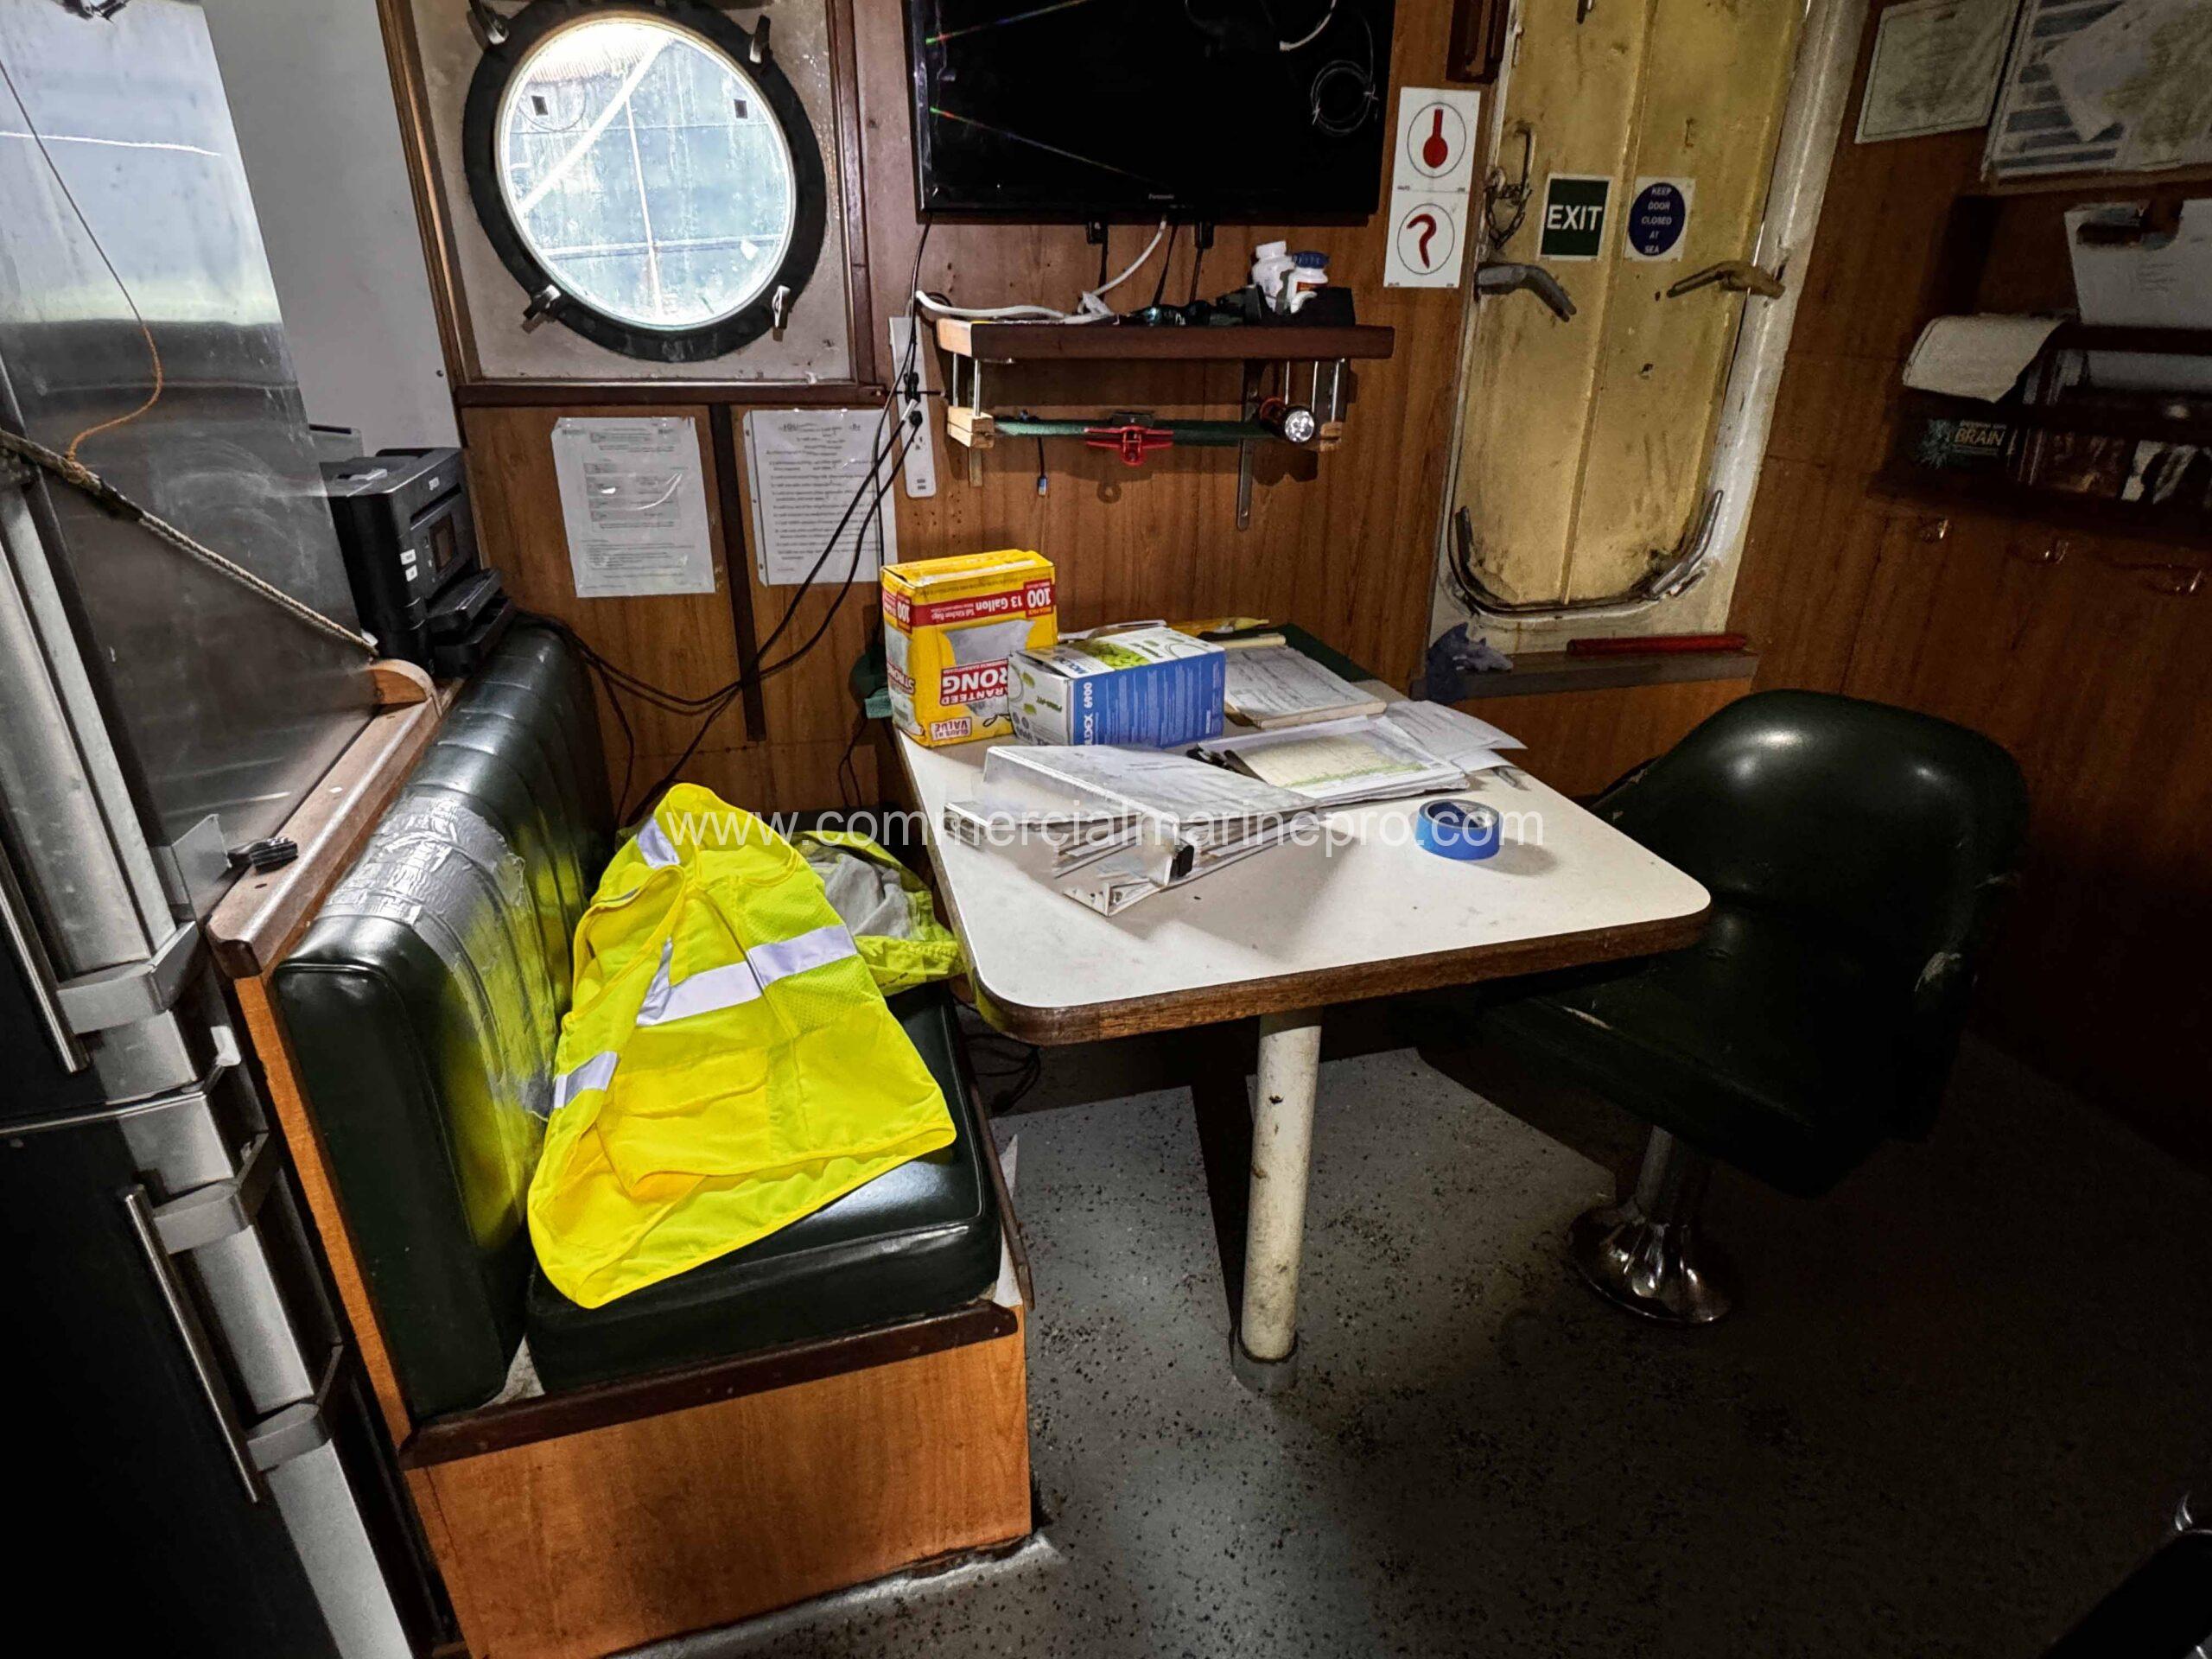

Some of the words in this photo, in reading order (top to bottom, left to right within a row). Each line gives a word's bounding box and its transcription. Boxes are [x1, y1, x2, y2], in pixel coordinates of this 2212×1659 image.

[1651, 187, 1672, 195] KEEP
[1648, 201, 1670, 210] DOOR
[1547, 205, 1603, 231] EXIT
[1642, 216, 1672, 226] CLOSED
[1649, 230, 1660, 240] AT
[1644, 245, 1659, 254] SEA
[1010, 595, 1023, 608] 13
[1027, 587, 1052, 608] 100
[975, 597, 1008, 613] Gallon
[943, 666, 1008, 695] RONG
[1084, 682, 1093, 709] 6900
[1084, 713, 1094, 745] LDEX
